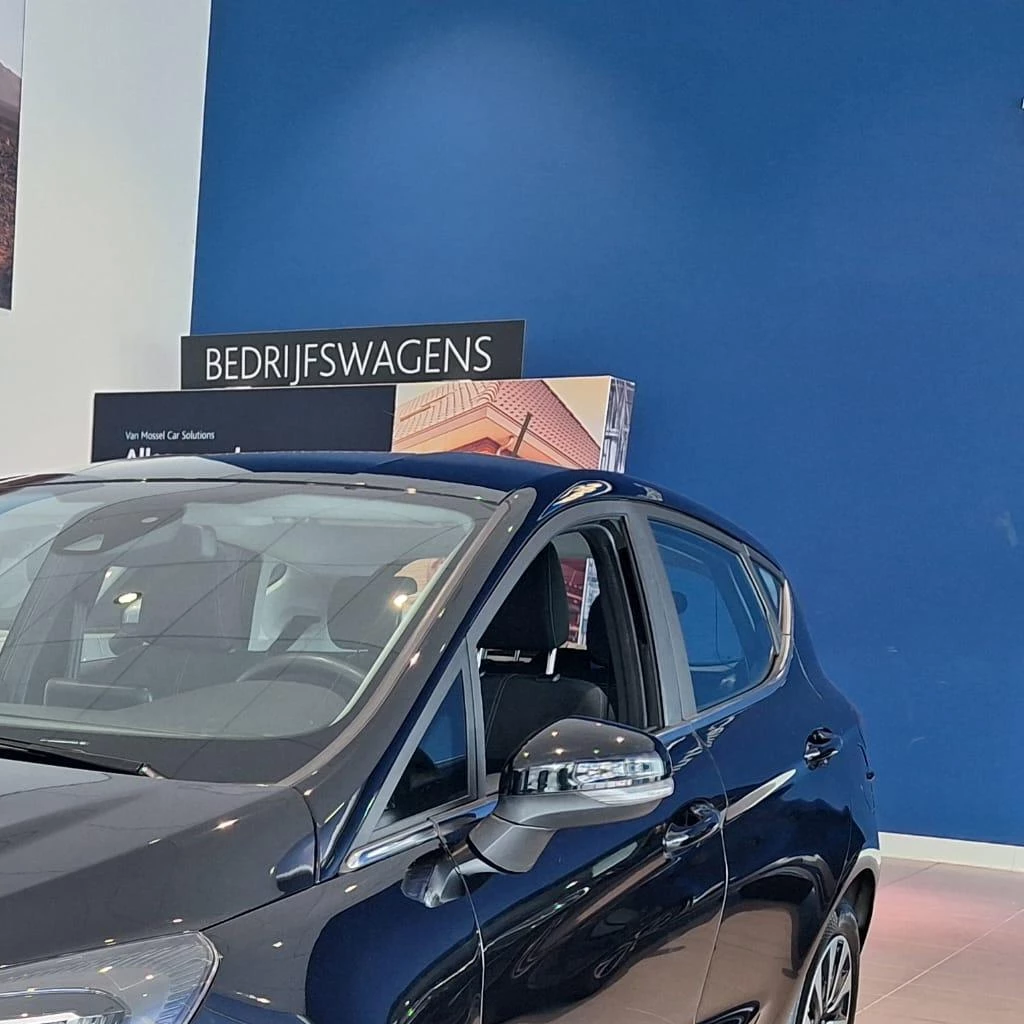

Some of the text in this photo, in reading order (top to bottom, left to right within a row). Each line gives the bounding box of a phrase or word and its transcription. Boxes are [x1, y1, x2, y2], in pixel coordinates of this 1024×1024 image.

[206, 336, 492, 386] BEDRIJFSWAGENS
[125, 430, 215, 440] Van Mossel Car Solutions
